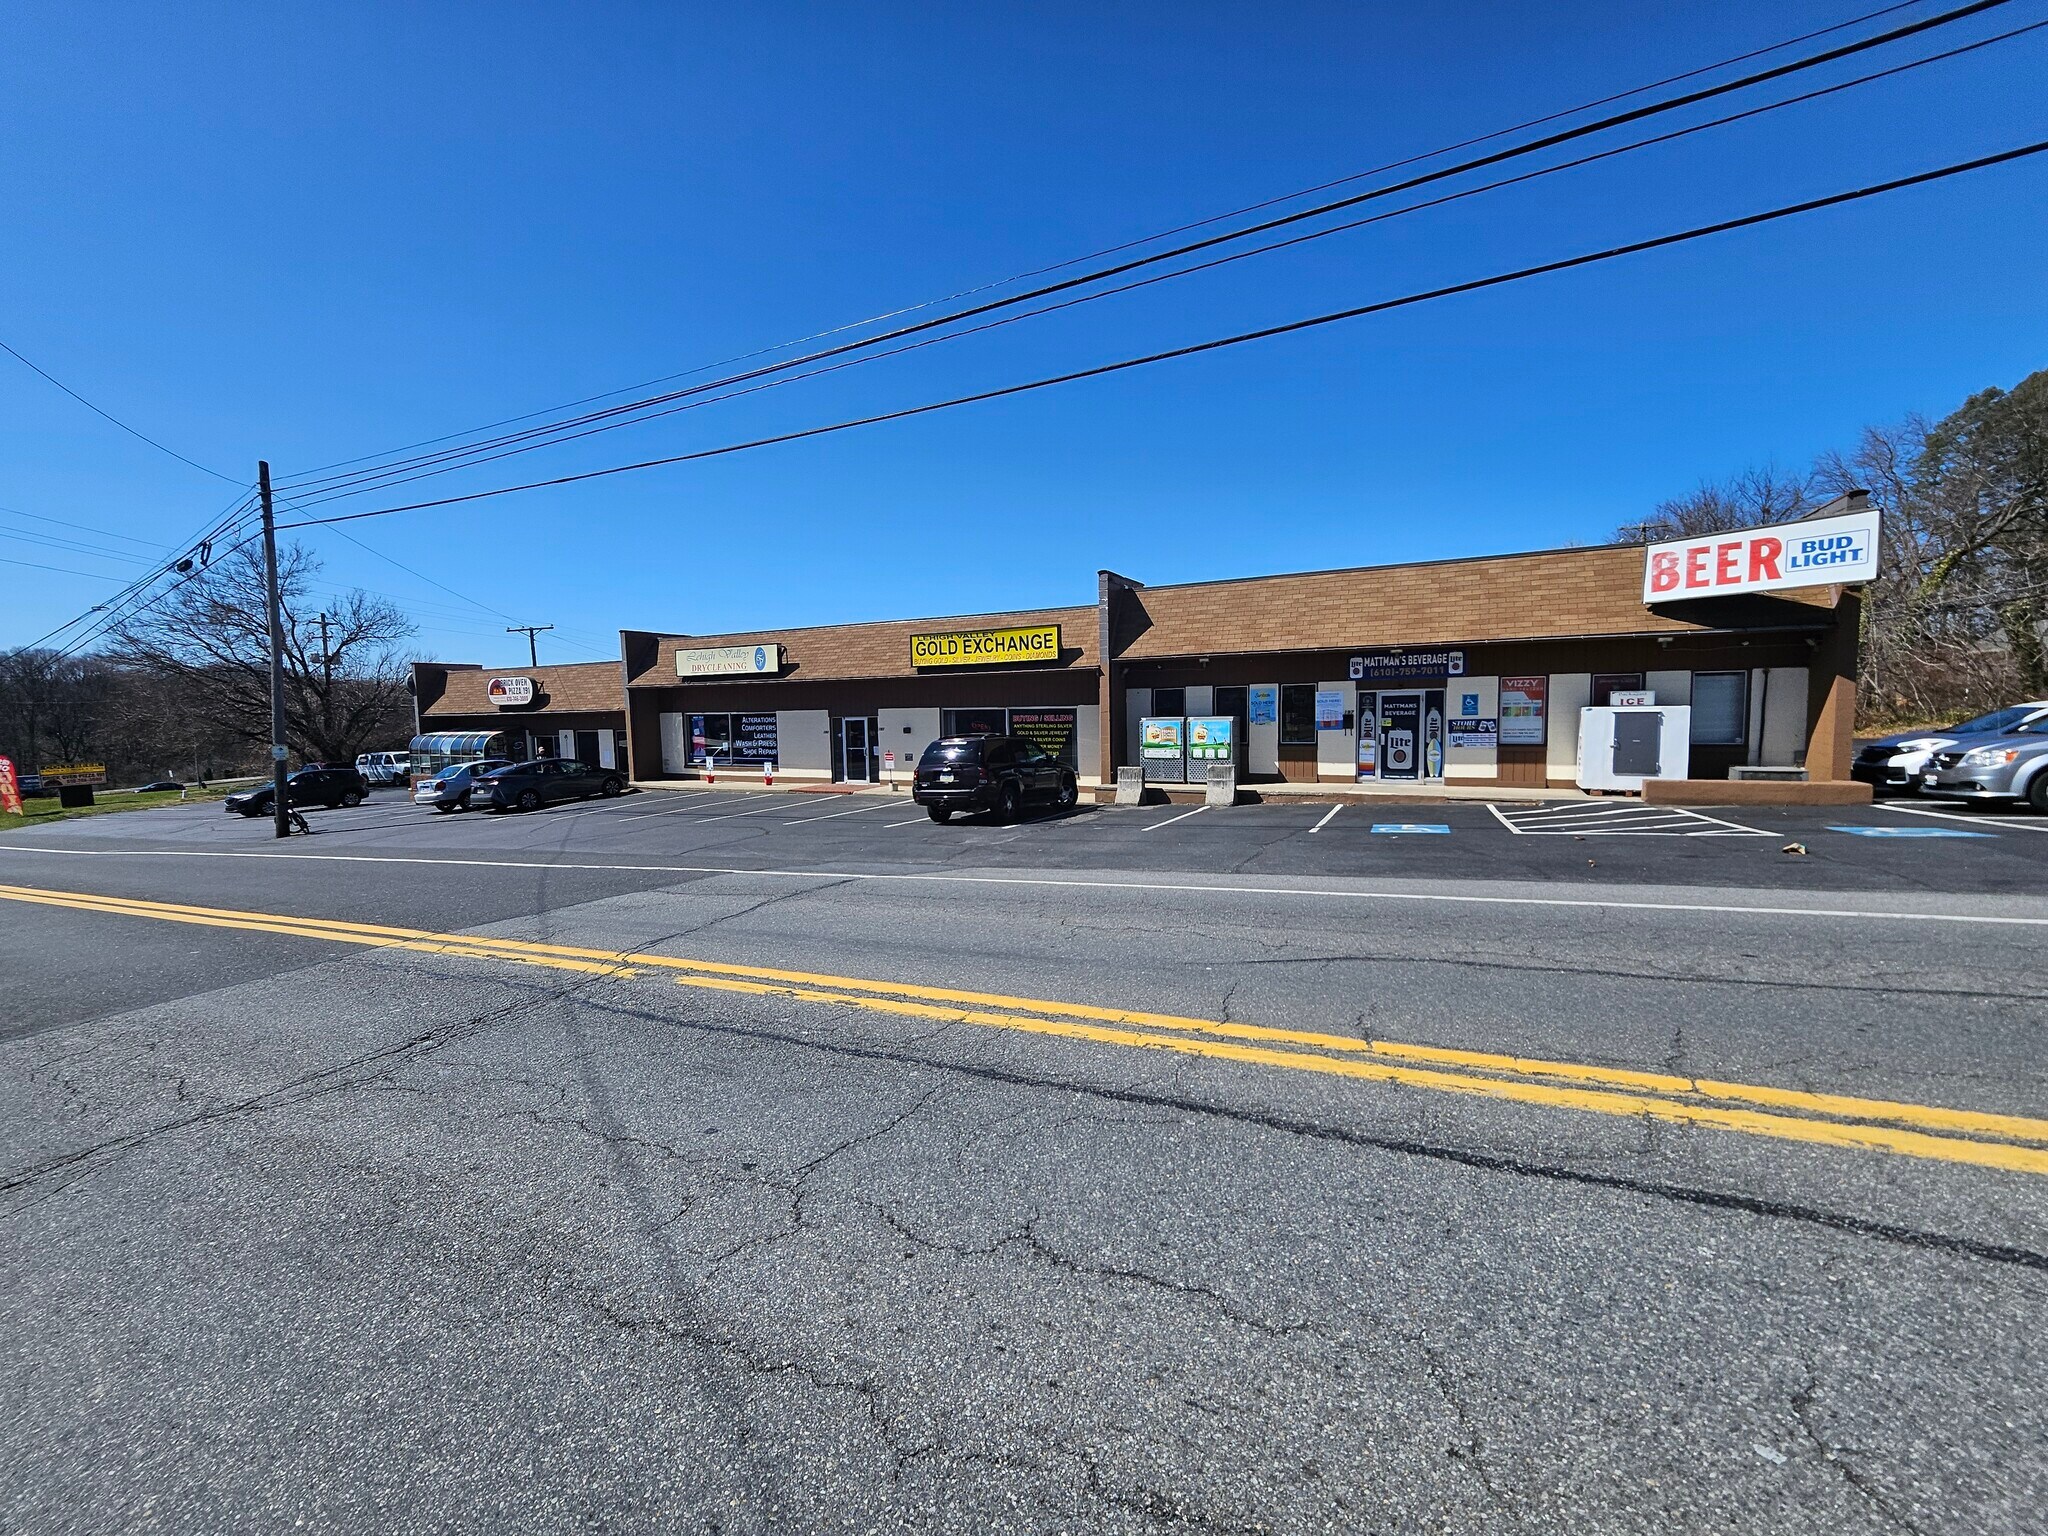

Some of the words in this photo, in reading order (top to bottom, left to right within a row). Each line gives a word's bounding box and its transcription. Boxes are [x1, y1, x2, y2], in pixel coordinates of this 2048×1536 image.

[1801, 536, 1853, 554] BUD
[1651, 536, 1783, 593] BEER
[1791, 548, 1863, 569] LIGHT
[957, 631, 996, 639] VALLEY
[915, 639, 958, 657] GOLD
[963, 633, 1054, 654] EXCHANGE
[687, 651, 716, 663] Lehigh
[718, 649, 750, 661] Valley
[933, 657, 949, 665] GOLD
[951, 656, 970, 664] SILVER
[974, 654, 1000, 663] JEWELRY
[1005, 653, 1022, 661] COINS
[1025, 651, 1057, 660] DIAMONDS
[1364, 655, 1407, 667] MATTMAN'S
[1408, 653, 1448, 665] BEVERAGE
[691, 662, 747, 672] DRYCLEANING
[1370, 666, 1444, 677] (610)-759-7011
[508, 687, 521, 695] PIZZA
[1620, 697, 1645, 706] ICE
[1043, 714, 1074, 722] SELLING
[1390, 737, 1411, 749] Lite
